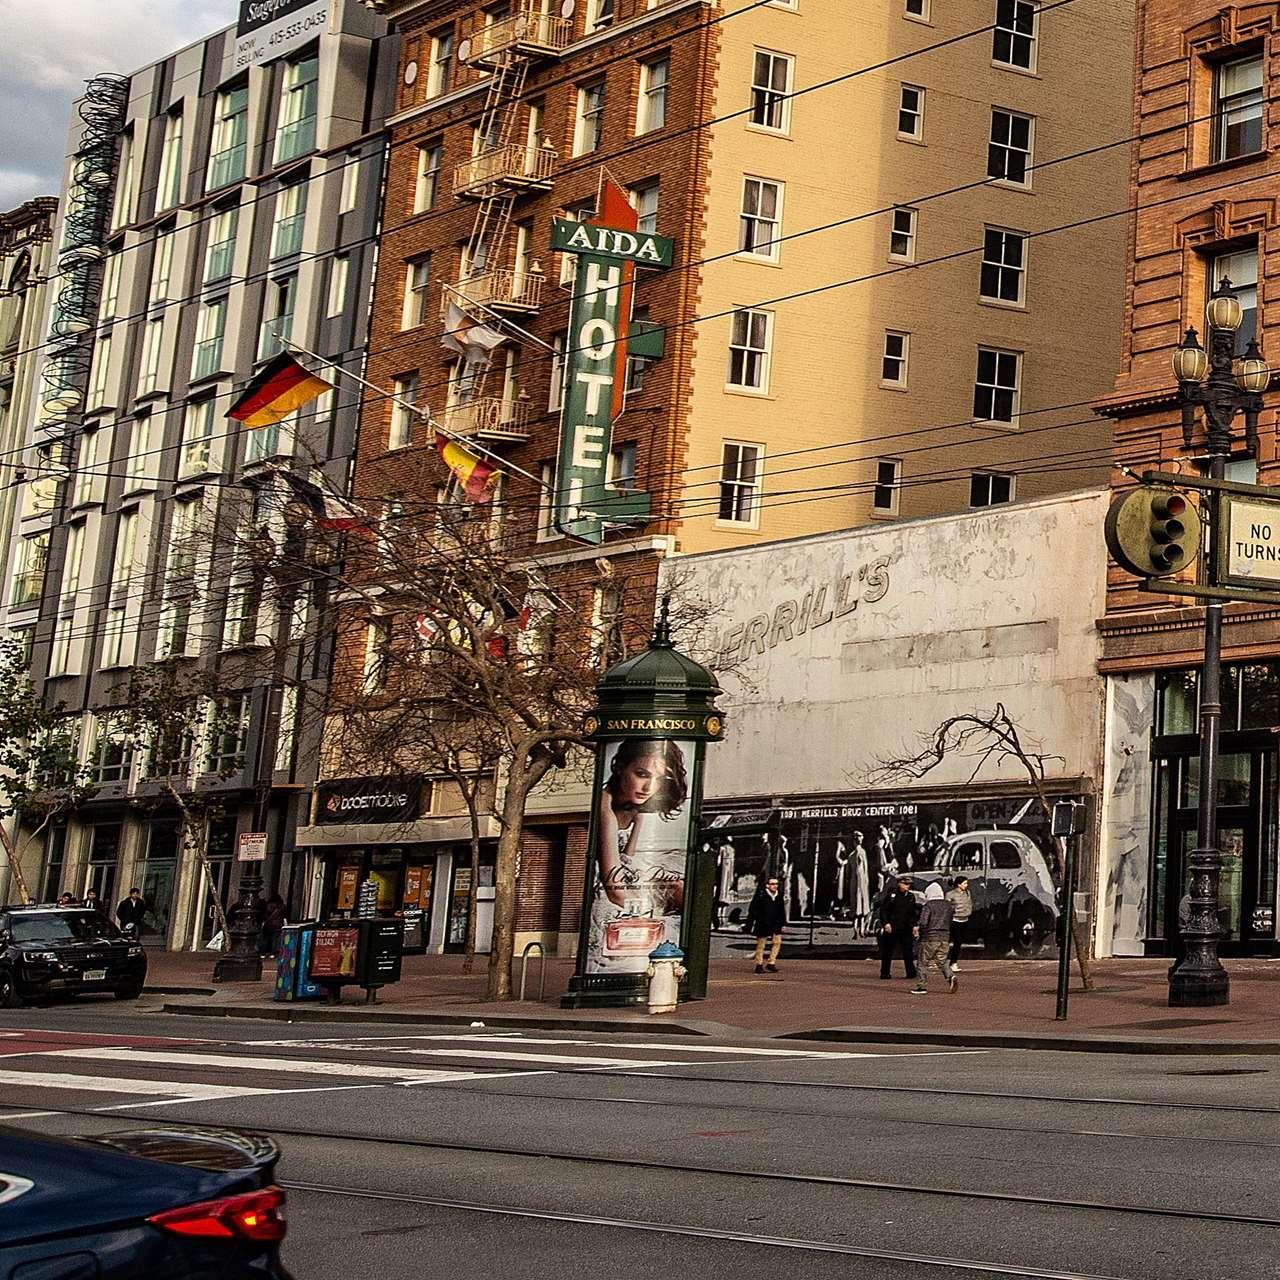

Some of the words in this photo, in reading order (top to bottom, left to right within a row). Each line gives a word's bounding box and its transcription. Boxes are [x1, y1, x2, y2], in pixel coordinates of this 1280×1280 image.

[239, 40, 256, 52] NOW
[236, 47, 265, 67] SELLING
[566, 227, 662, 263] AIDA
[568, 262, 621, 521] HOTEL
[1250, 523, 1272, 541] NO
[607, 719, 628, 730] SAN
[630, 719, 696, 730] FRANCISCO
[801, 808, 838, 818] MERRILLS
[841, 807, 862, 817] DRUG
[864, 805, 895, 816] CENTER
